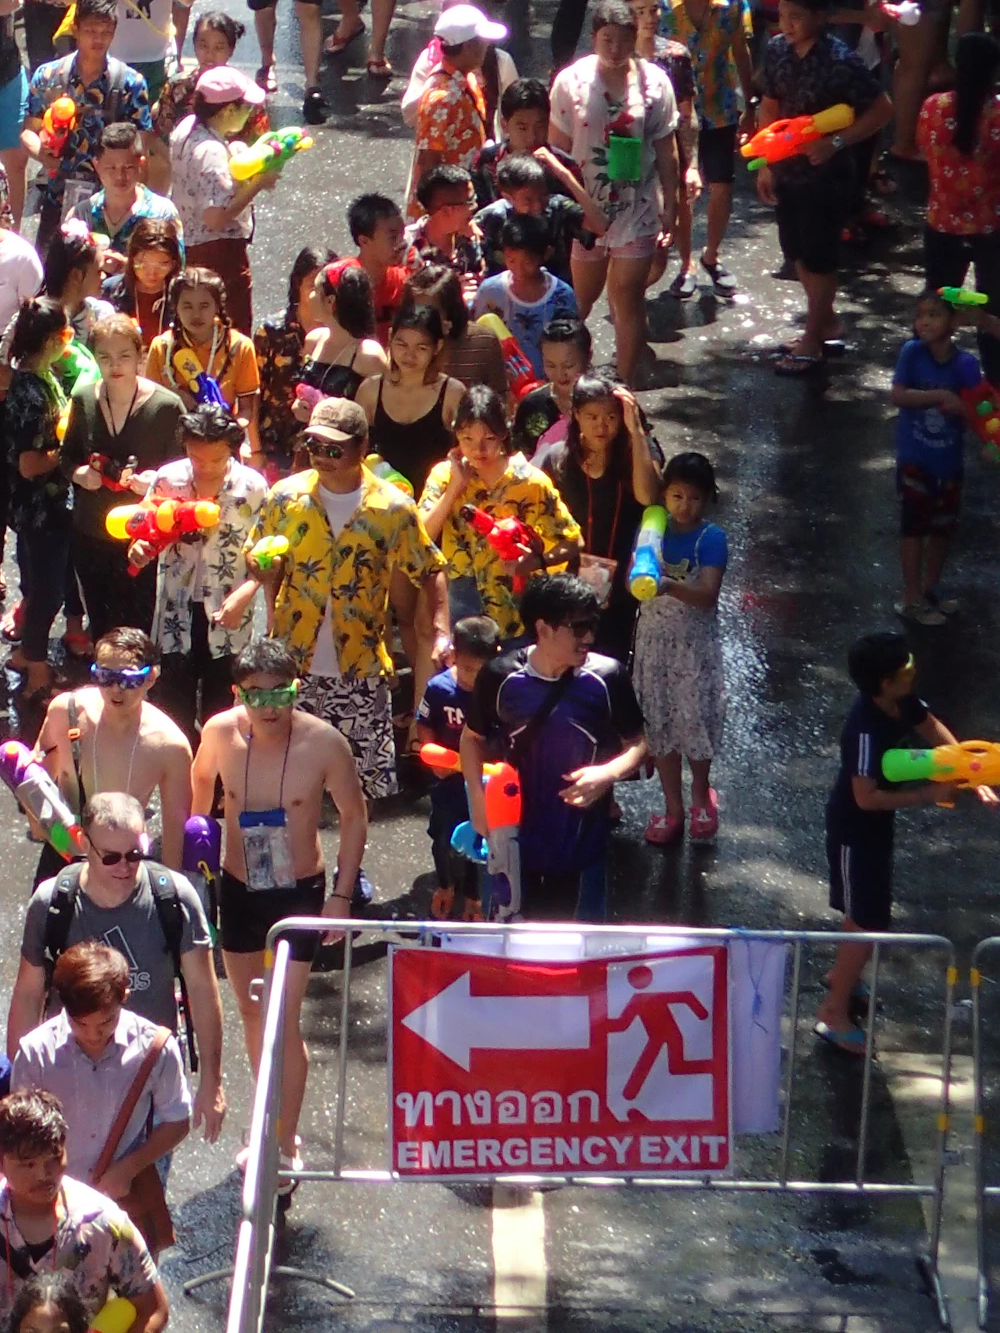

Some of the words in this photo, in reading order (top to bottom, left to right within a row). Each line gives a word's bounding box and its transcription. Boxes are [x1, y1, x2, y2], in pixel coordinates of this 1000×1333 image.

[396, 1089, 600, 1128] ทางออก
[397, 1136, 634, 1169] EMERGENCY
[640, 1135, 726, 1165] EXIT
